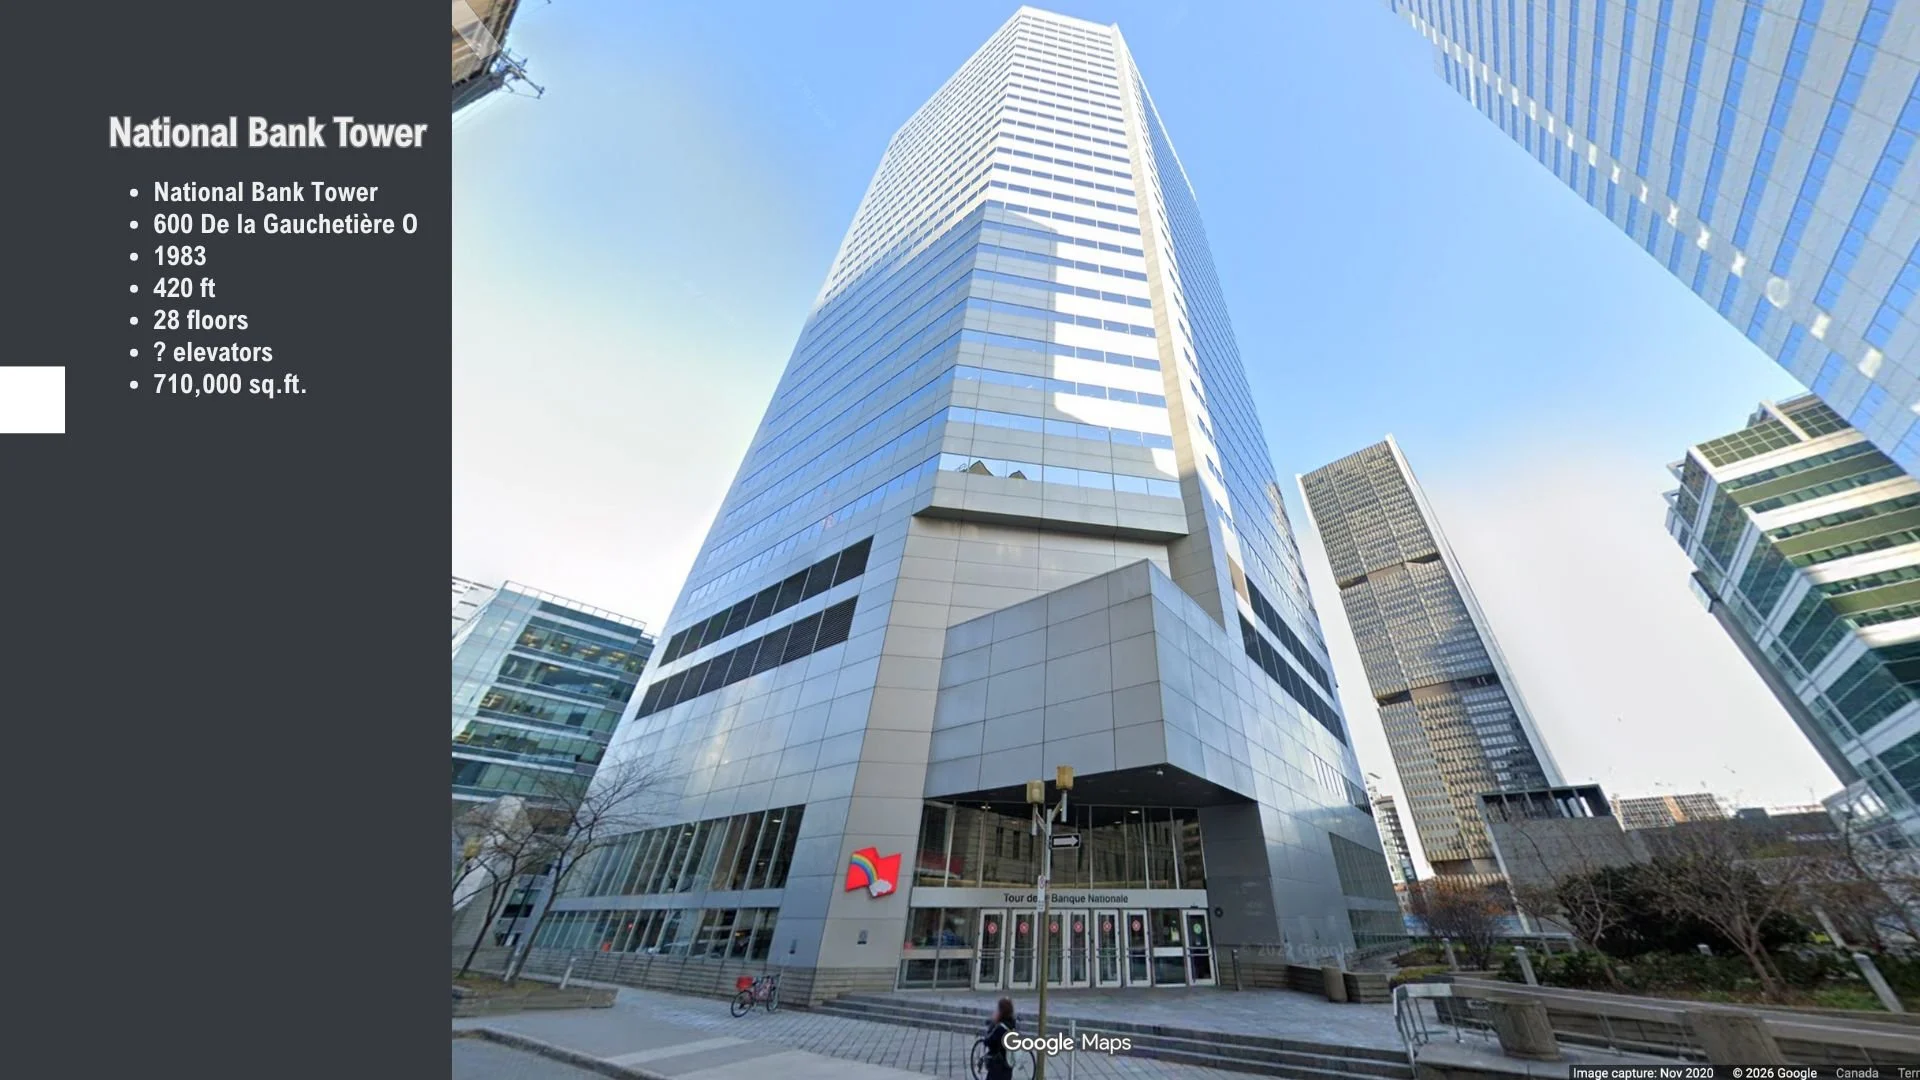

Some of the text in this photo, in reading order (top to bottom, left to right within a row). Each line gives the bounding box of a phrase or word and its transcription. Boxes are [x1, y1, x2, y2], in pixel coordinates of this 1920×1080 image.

[1003, 892, 1024, 904] Tour
[1050, 892, 1087, 906] Banque
[1087, 892, 1129, 904] Nationale
